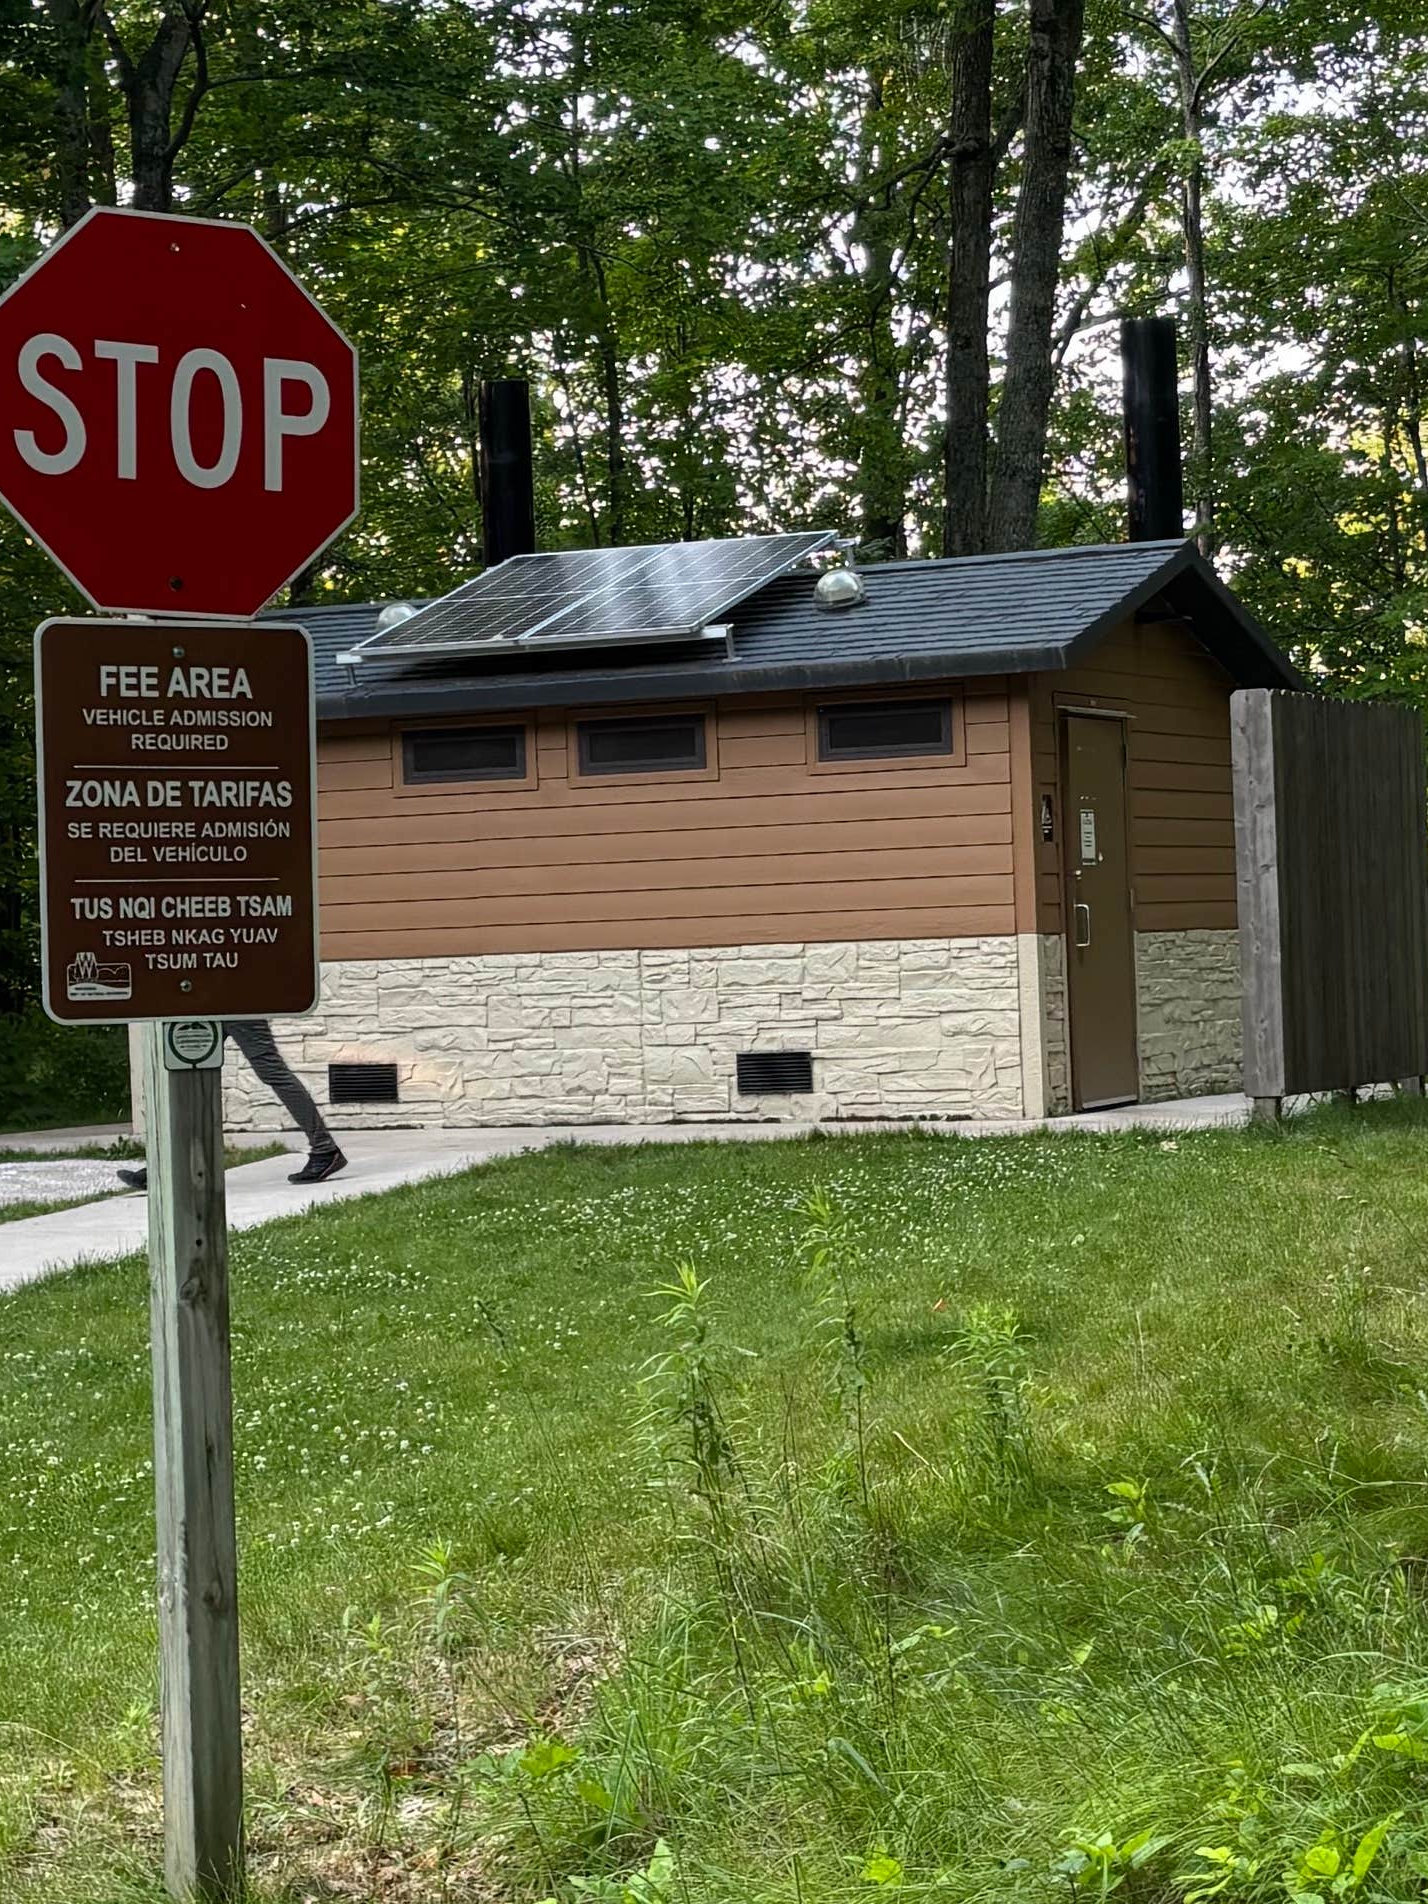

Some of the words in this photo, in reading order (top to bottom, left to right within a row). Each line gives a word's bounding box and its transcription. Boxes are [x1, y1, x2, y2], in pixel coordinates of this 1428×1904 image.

[13, 332, 330, 492] STOP
[100, 665, 159, 697] FEE
[167, 667, 253, 699] AREA
[83, 708, 165, 725] VEHICLE
[170, 710, 273, 727] ADMISSION
[132, 733, 228, 751] REQUIRED
[65, 780, 141, 807] ZONA
[147, 781, 181, 807] DE
[189, 781, 292, 807] TARIFAS
[67, 822, 93, 838] SE
[99, 822, 196, 839] REQUIERE
[201, 819, 291, 838] ADMISIÓN
[110, 847, 147, 862] DEL
[153, 842, 247, 862] VEHÍCULO
[71, 897, 113, 920] TUS
[119, 897, 155, 919] NQI
[161, 896, 231, 918] CHEEB
[236, 895, 292, 917] TSAM
[102, 929, 166, 946] TSHEB
[171, 928, 224, 944] NKAG
[230, 927, 278, 944] YUAV
[145, 953, 197, 970] TSUM
[203, 952, 239, 968] TAU
